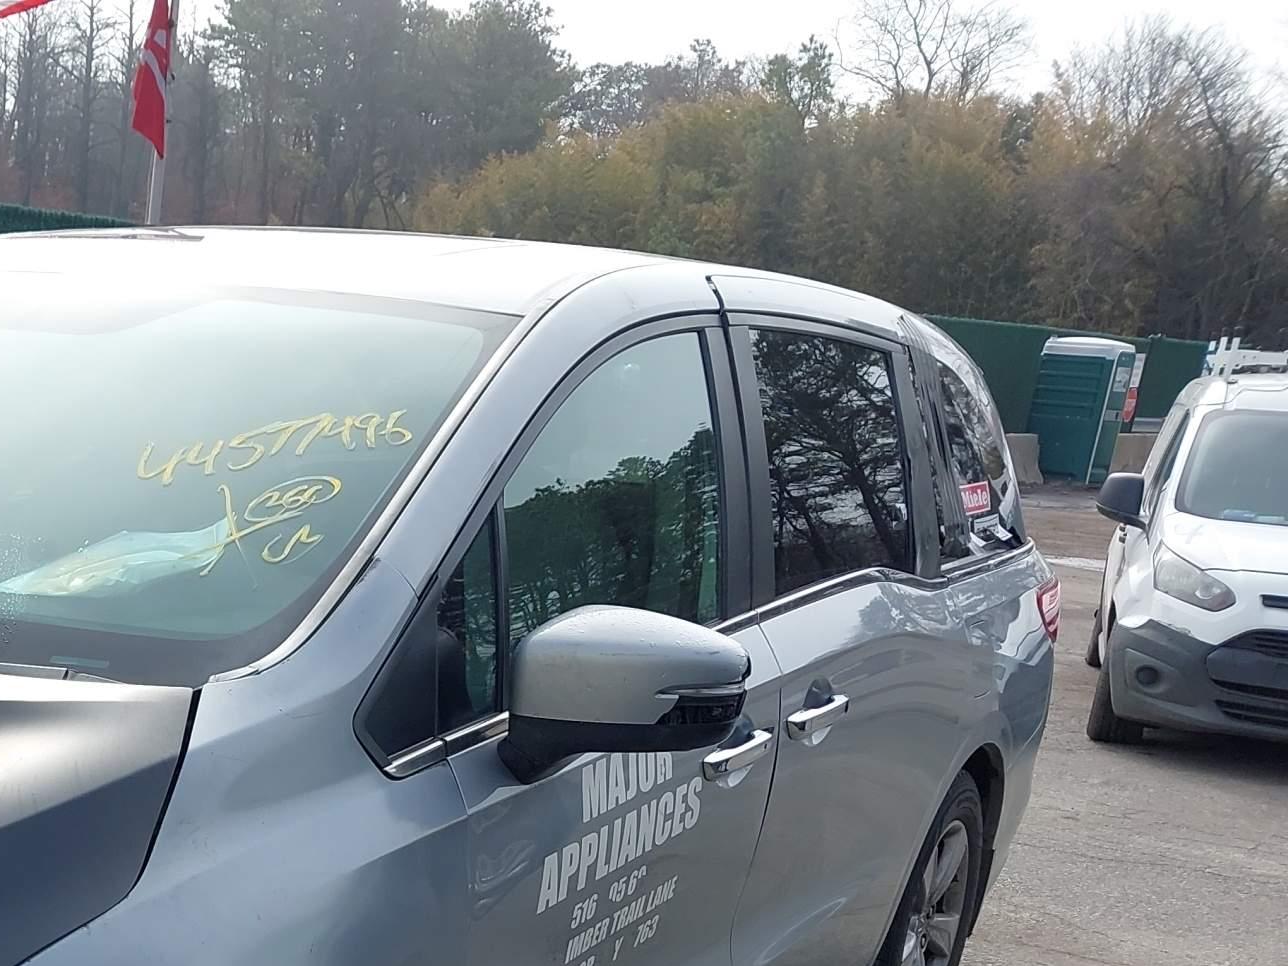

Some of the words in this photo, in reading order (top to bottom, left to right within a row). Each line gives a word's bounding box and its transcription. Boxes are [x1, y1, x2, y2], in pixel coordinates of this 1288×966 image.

[960, 487, 989, 510] Miele
[582, 751, 673, 824] MAJOR
[536, 776, 703, 915] APPLIANCES
[570, 893, 599, 929] 516
[610, 895, 647, 936] TRAIL
[646, 875, 679, 914] LANE
